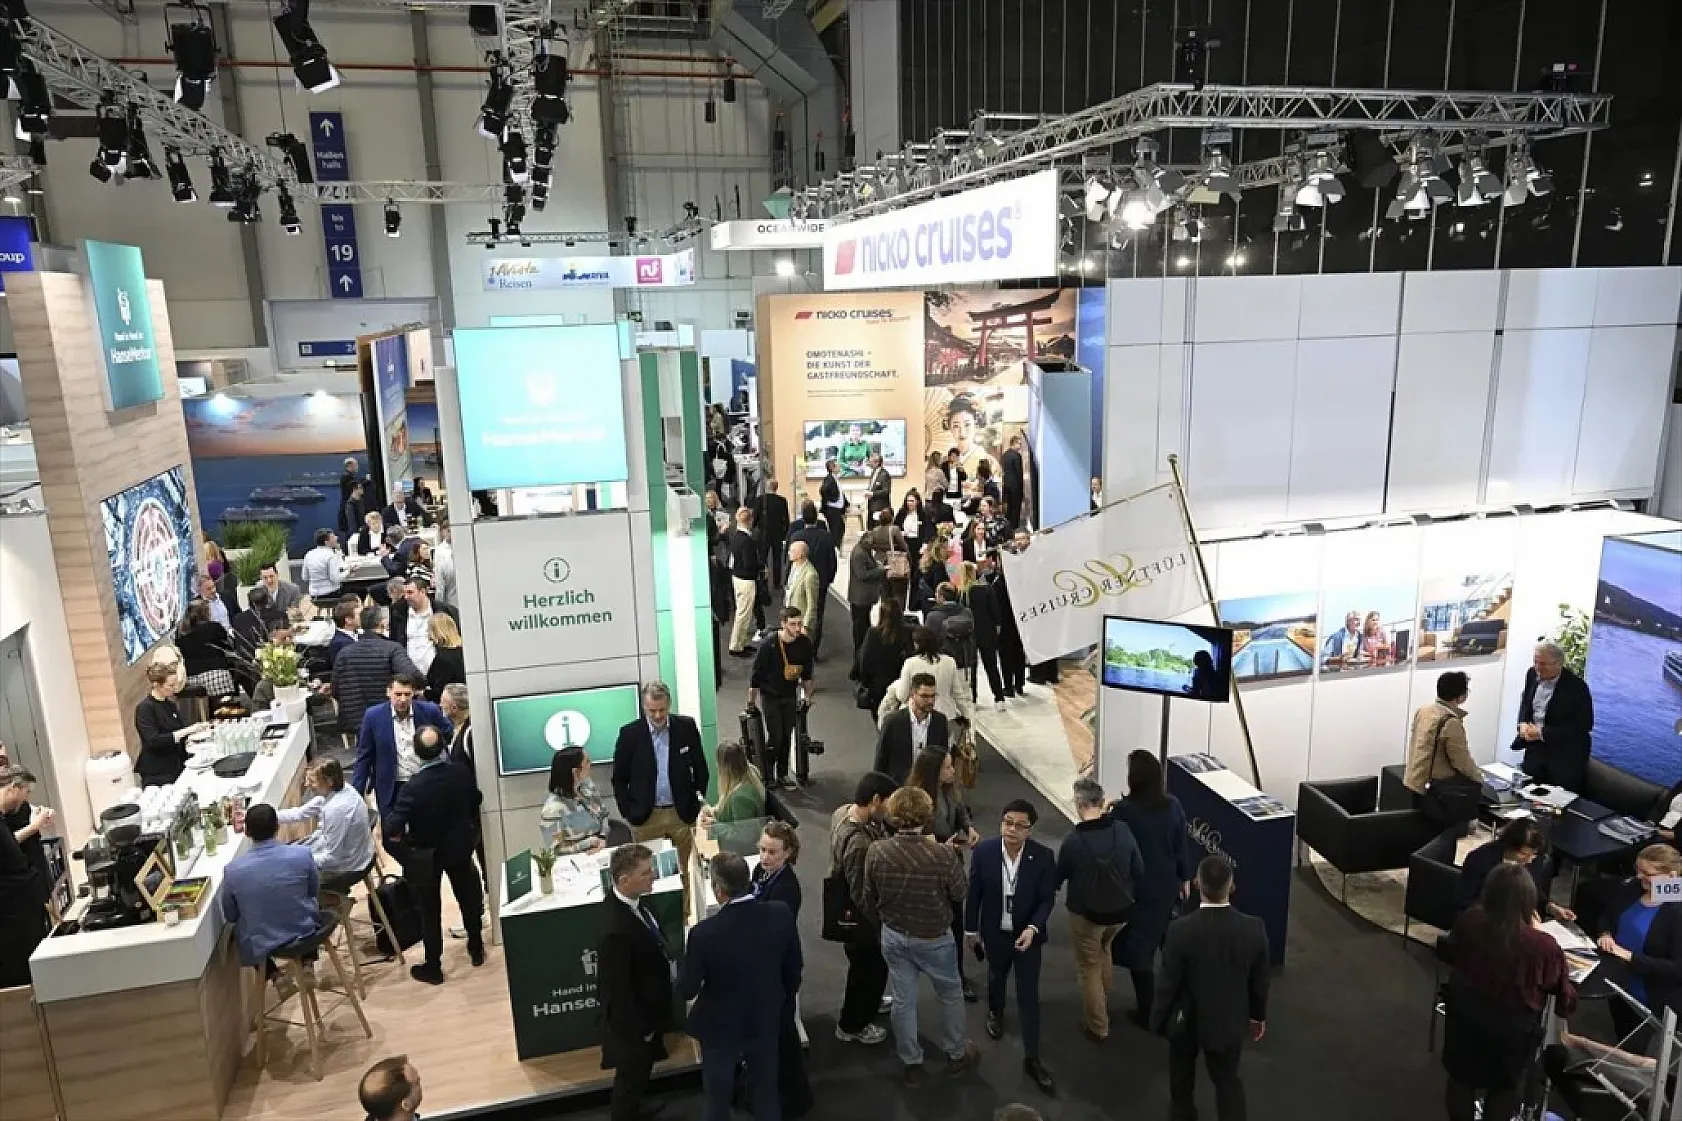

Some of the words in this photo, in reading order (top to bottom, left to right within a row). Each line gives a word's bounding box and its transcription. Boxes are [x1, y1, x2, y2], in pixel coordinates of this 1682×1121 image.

[863, 228, 908, 273] nicko
[915, 205, 1013, 267] cruises
[331, 244, 354, 261] 19
[816, 310, 848, 320] nicko
[849, 308, 892, 319] cruises
[806, 350, 864, 359] OMOTENASHI
[806, 361, 820, 369] DIE
[823, 360, 851, 369] KUNST
[854, 360, 871, 368] DER
[523, 588, 595, 608] Herzlich
[508, 610, 613, 631] willkommen
[1655, 883, 1681, 895] 105
[551, 984, 583, 997] Hand
[586, 983, 598, 992] in
[532, 996, 600, 1018] Hanse
